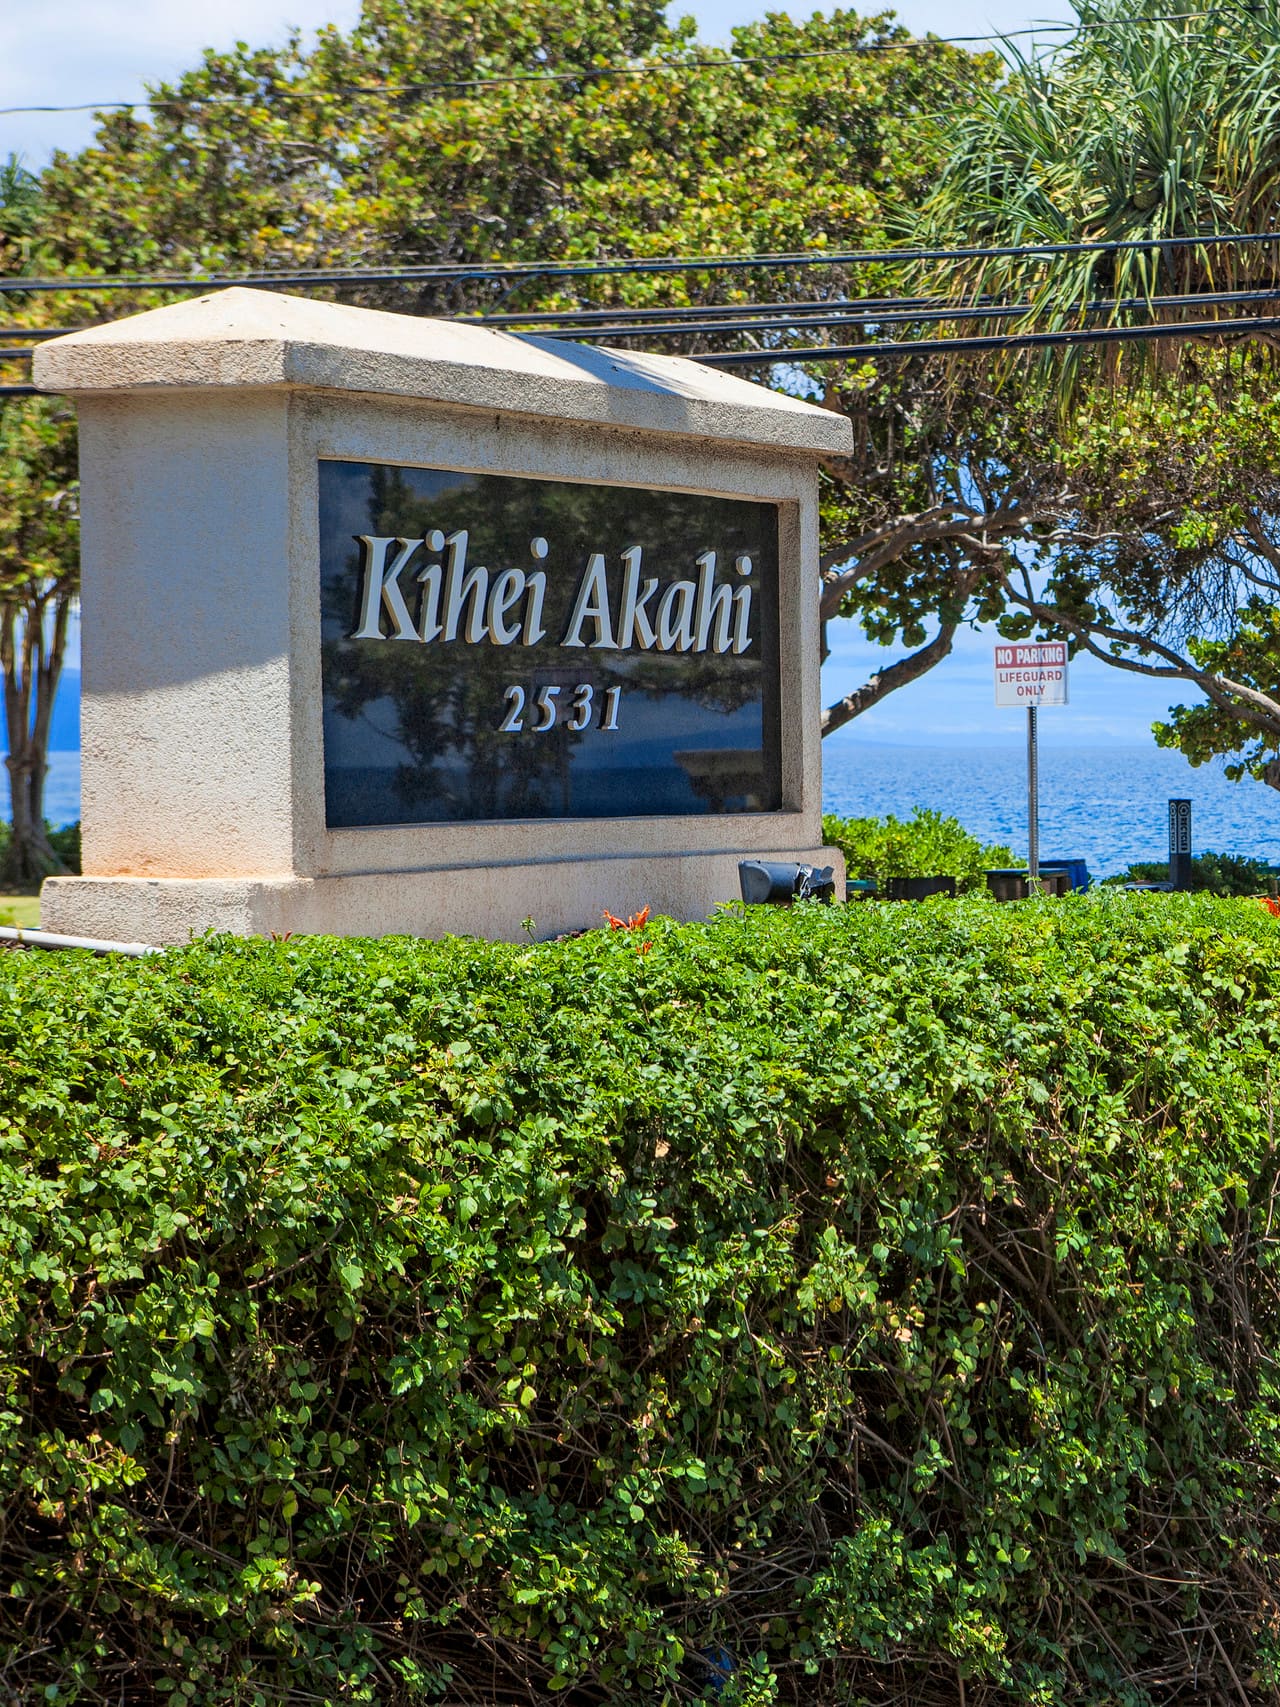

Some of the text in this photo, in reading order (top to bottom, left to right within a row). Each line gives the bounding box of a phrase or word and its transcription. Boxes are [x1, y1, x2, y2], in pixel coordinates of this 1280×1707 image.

[351, 529, 753, 655] Kihei Akahi
[997, 646, 1064, 665] NO PARKING
[999, 670, 1063, 683] LIFEGUARD
[1016, 684, 1046, 697] ONLY
[500, 683, 622, 732] 2531
